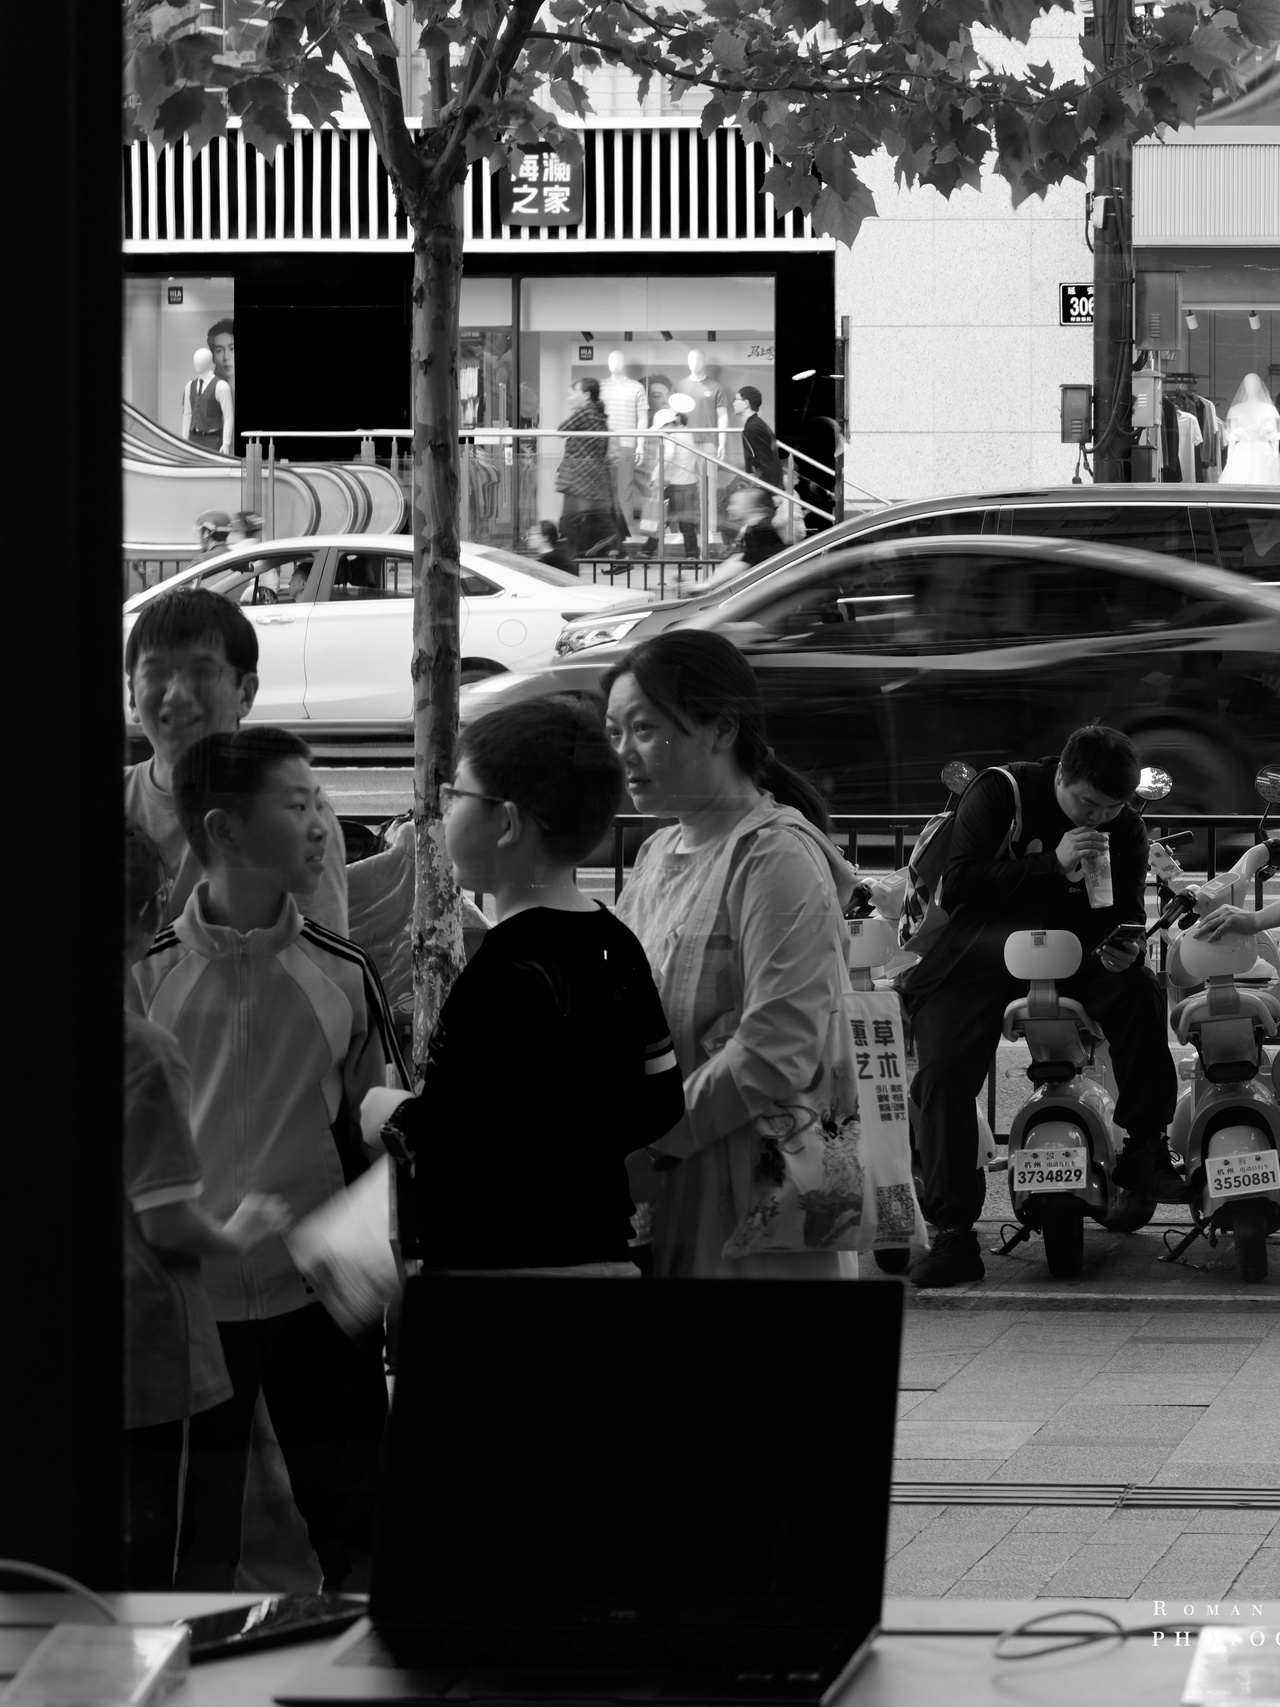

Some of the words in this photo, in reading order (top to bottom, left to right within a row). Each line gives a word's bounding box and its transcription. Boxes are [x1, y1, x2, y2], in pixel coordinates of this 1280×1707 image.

[511, 184, 570, 214] 之家
[856, 1052, 900, 1080] 艺术
[1018, 1169, 1083, 1184] 3734829
[1214, 1171, 1276, 1191] 3550881
[1217, 1167, 1234, 1176] 杭州
